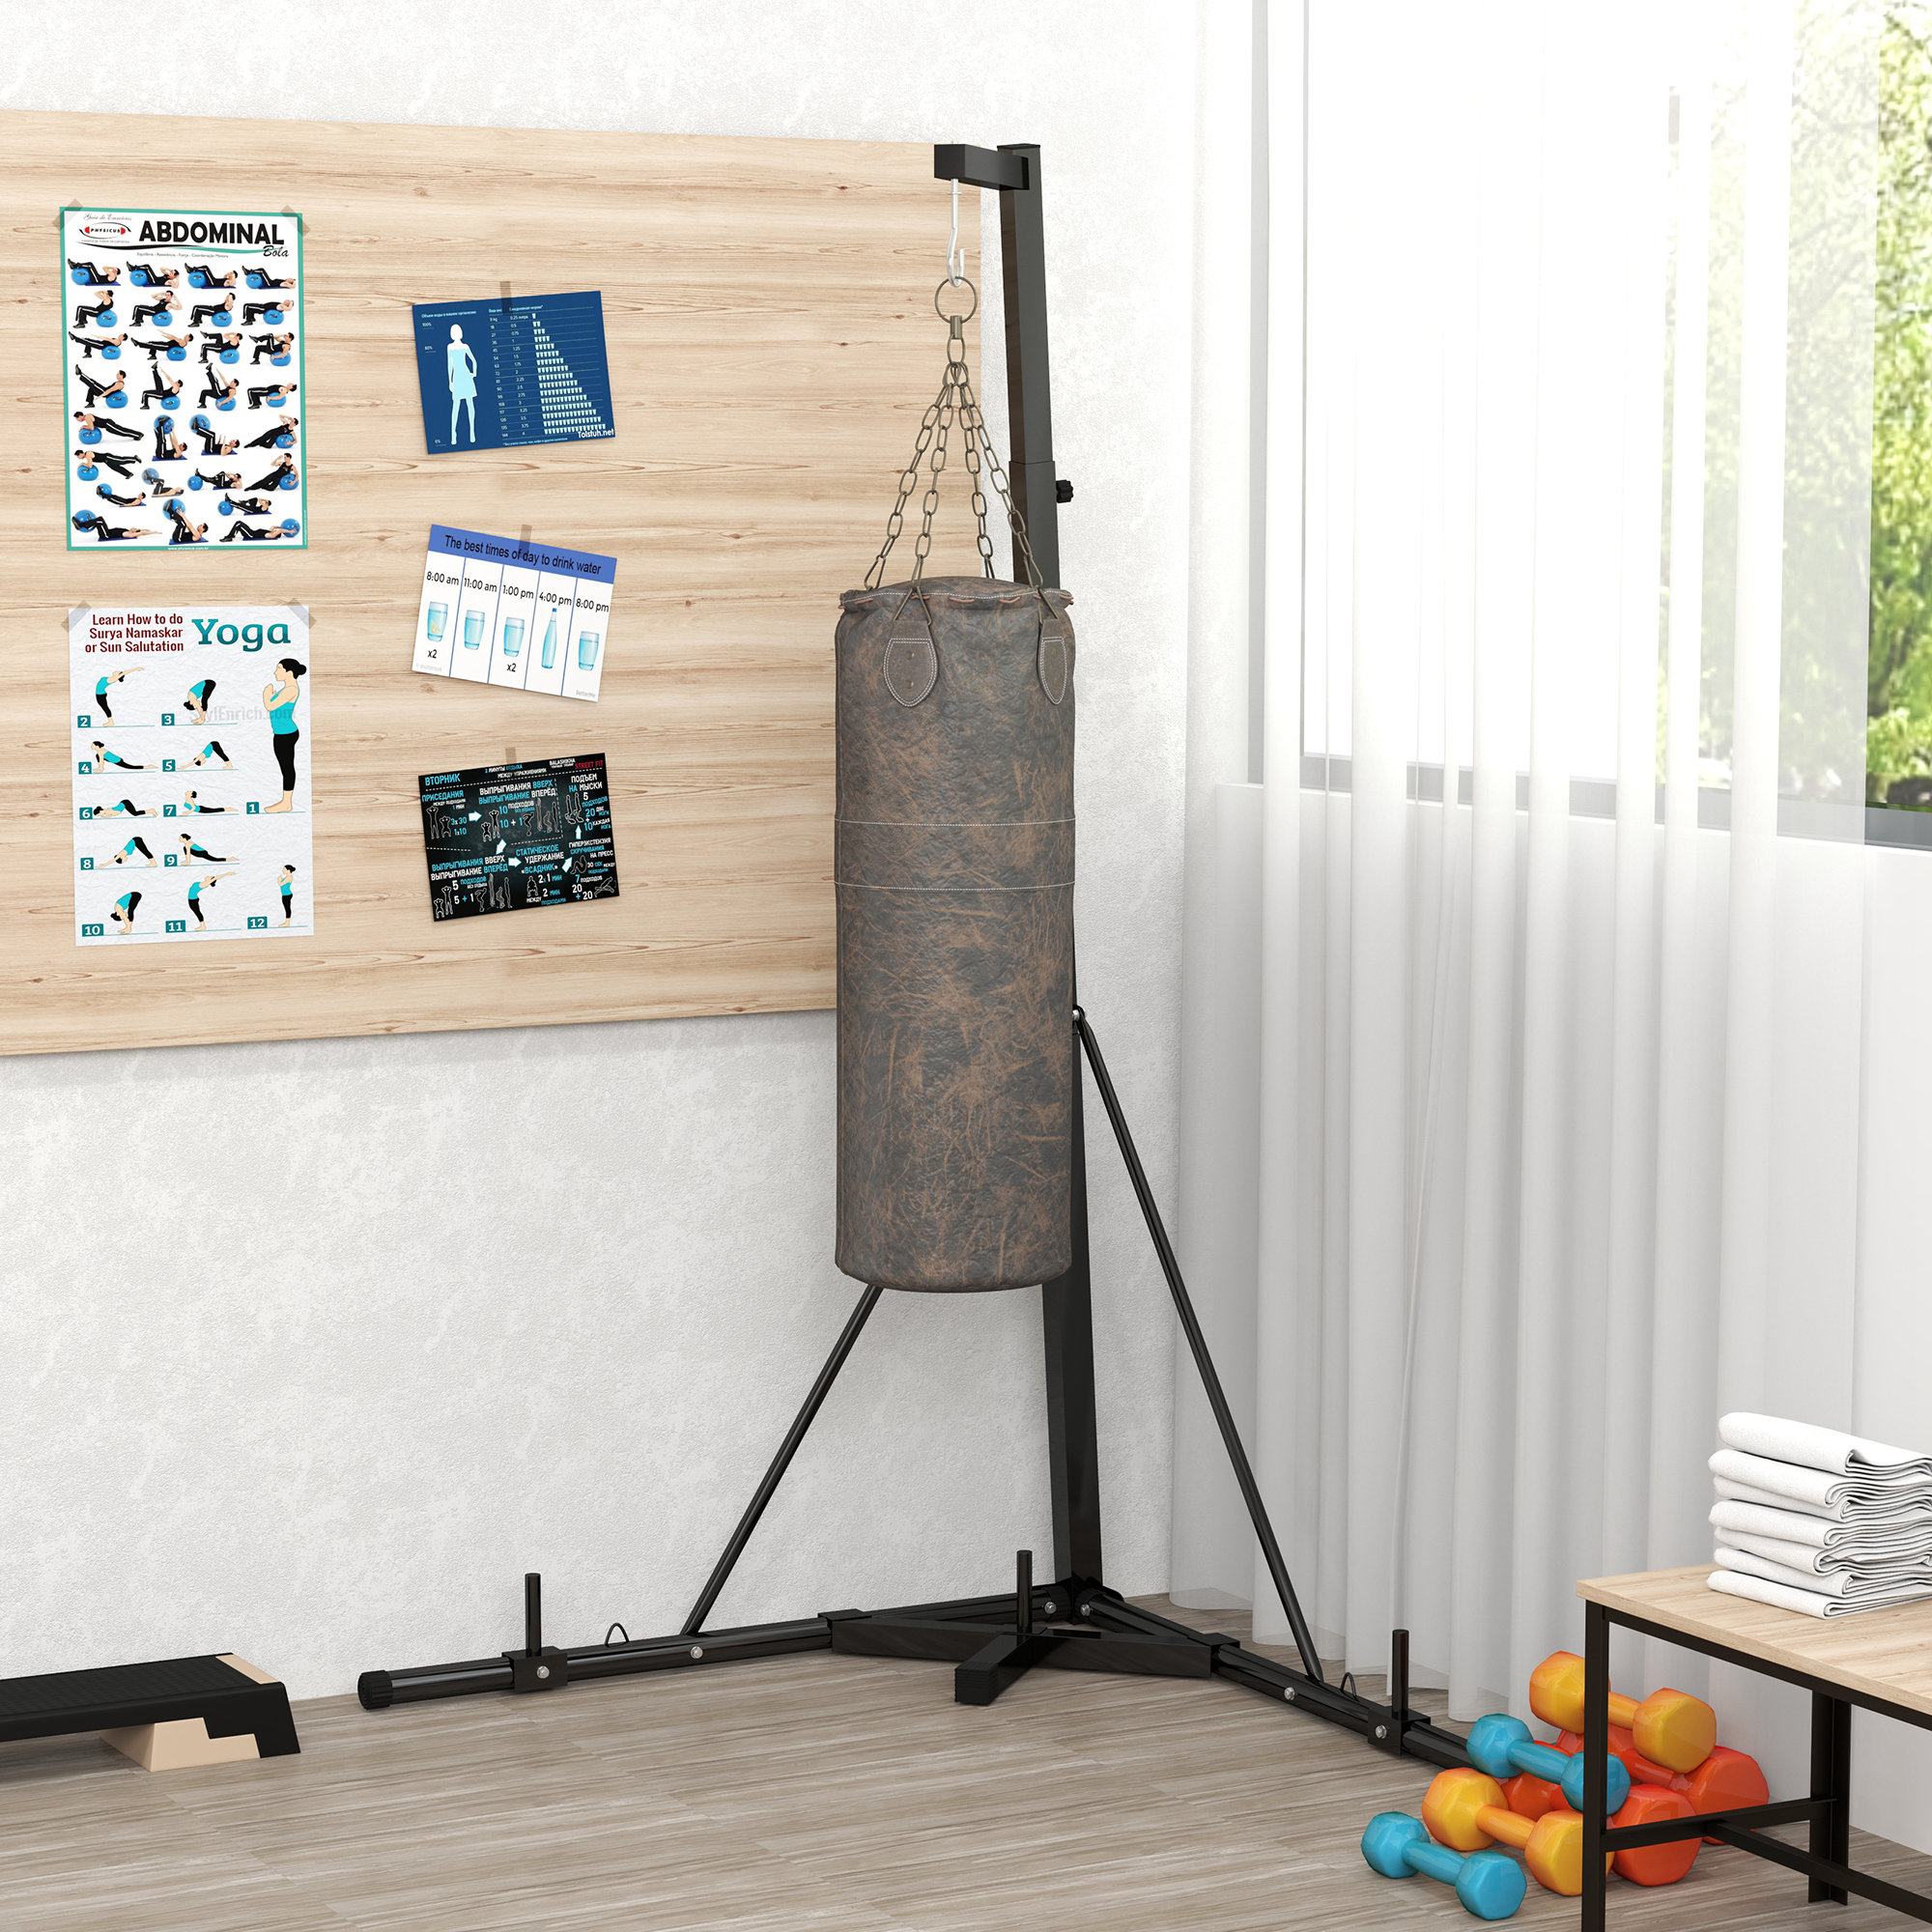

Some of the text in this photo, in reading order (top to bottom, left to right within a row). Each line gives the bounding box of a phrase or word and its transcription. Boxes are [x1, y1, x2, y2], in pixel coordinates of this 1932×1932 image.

[139, 220, 285, 244] ABDOMINAL
[263, 244, 289, 258] Bola
[577, 428, 614, 439] Tolstuh.net
[444, 534, 602, 575] The best times of day to drink water
[426, 571, 460, 586] 8:00 am
[464, 578, 497, 592] 11:00 am
[502, 584, 534, 600] 1:00 pm
[539, 591, 572, 607] 4:00 pm
[575, 598, 610, 613] 8:00 pm
[92, 612, 184, 626] Learn How to do
[89, 626, 184, 640] Surya Namaskar
[191, 618, 292, 652] Yoga
[85, 640, 184, 653] or Sun Salutation
[427, 648, 438, 659] x2
[506, 663, 517, 673] x2
[79, 717, 88, 726] 2
[164, 715, 172, 724] 3
[80, 763, 90, 774] 4
[164, 760, 173, 771] 5
[574, 761, 594, 770] STREET
[425, 773, 461, 786] ВТОРНИК
[571, 773, 598, 783] ПОДЪЕМ
[479, 780, 554, 796] ВЫПРЫГИВАНИЯ ВВЕРХ
[568, 781, 603, 792] НА МЫСКИ
[421, 789, 464, 803] ПРИСЕДАНИЯ
[478, 787, 556, 805] ВЫПРЫГИВАНИЕ ВПЕРЁД
[582, 791, 589, 801] 5
[582, 795, 609, 808] ПОДХОДОВ
[165, 807, 174, 816] 7
[248, 804, 256, 813] 1
[498, 800, 535, 814] 10 ПОДХОДОВ
[584, 808, 596, 817] 20
[82, 809, 90, 819] 6
[499, 818, 509, 829] 10
[519, 816, 523, 826] 1
[583, 821, 593, 831] 10
[515, 843, 559, 857] СТАТИЧЕСКОЕ
[597, 849, 614, 858] ПРЕСС
[167, 856, 175, 866] 9
[431, 854, 505, 872] ВЫПРЫГИВАНИЯ ВВЕРХ
[525, 851, 565, 865] УДЕРЖАНИЕ
[83, 859, 92, 869] 8
[430, 863, 509, 881] ВЫПРЫГИВАНИЕ ВПЕРЁД
[451, 875, 487, 891] 5 ПОДХОДОВ
[575, 873, 581, 884] 7
[542, 888, 549, 897] 2
[571, 883, 582, 894] 20
[453, 895, 460, 904] 5
[469, 893, 474, 902] 1
[582, 890, 593, 900] 20
[168, 922, 183, 932] 11
[250, 919, 265, 928] 12
[84, 925, 101, 936] 10
